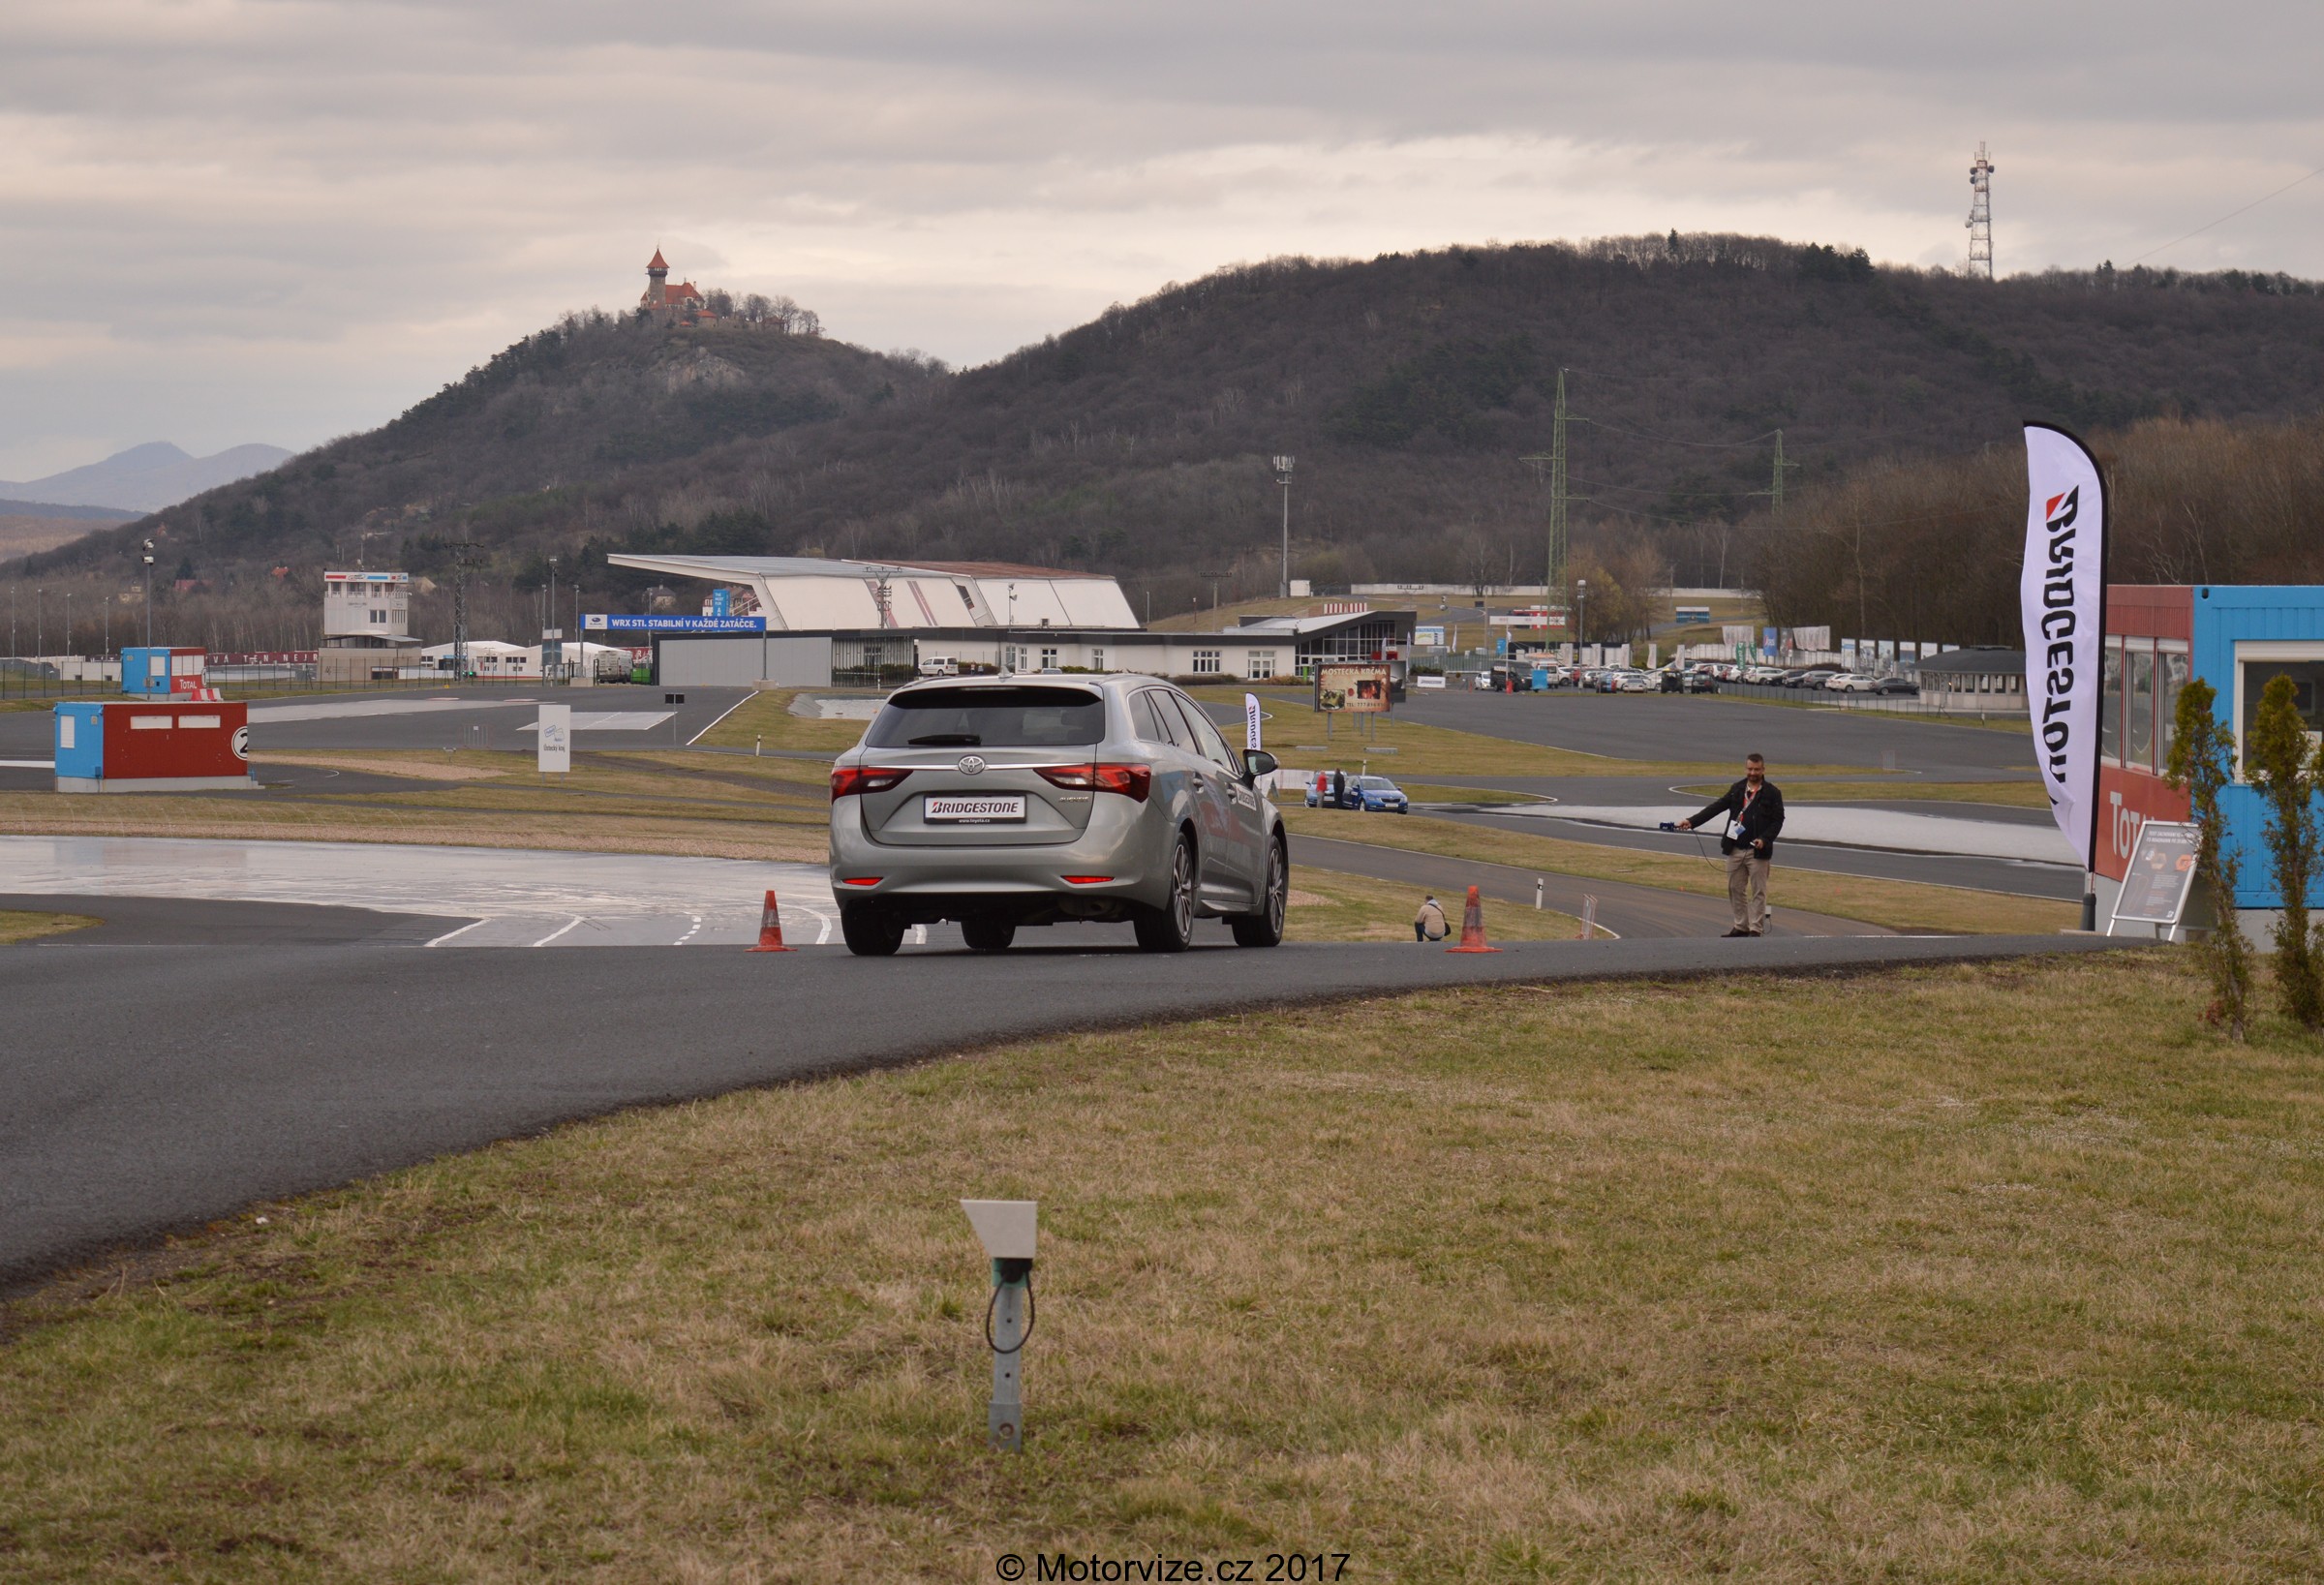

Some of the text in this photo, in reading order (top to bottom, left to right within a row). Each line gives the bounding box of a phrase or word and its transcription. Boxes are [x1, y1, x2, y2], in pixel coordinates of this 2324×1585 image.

[611, 619, 630, 627] WRX
[648, 618, 685, 627] STABILNÍ
[692, 618, 719, 628] KAŽDÉ
[719, 619, 757, 628] ZATÁČCE.
[179, 679, 198, 689] TOTAL
[931, 801, 1019, 814] BRIDGESTONE
[2109, 790, 2156, 860] TOT
